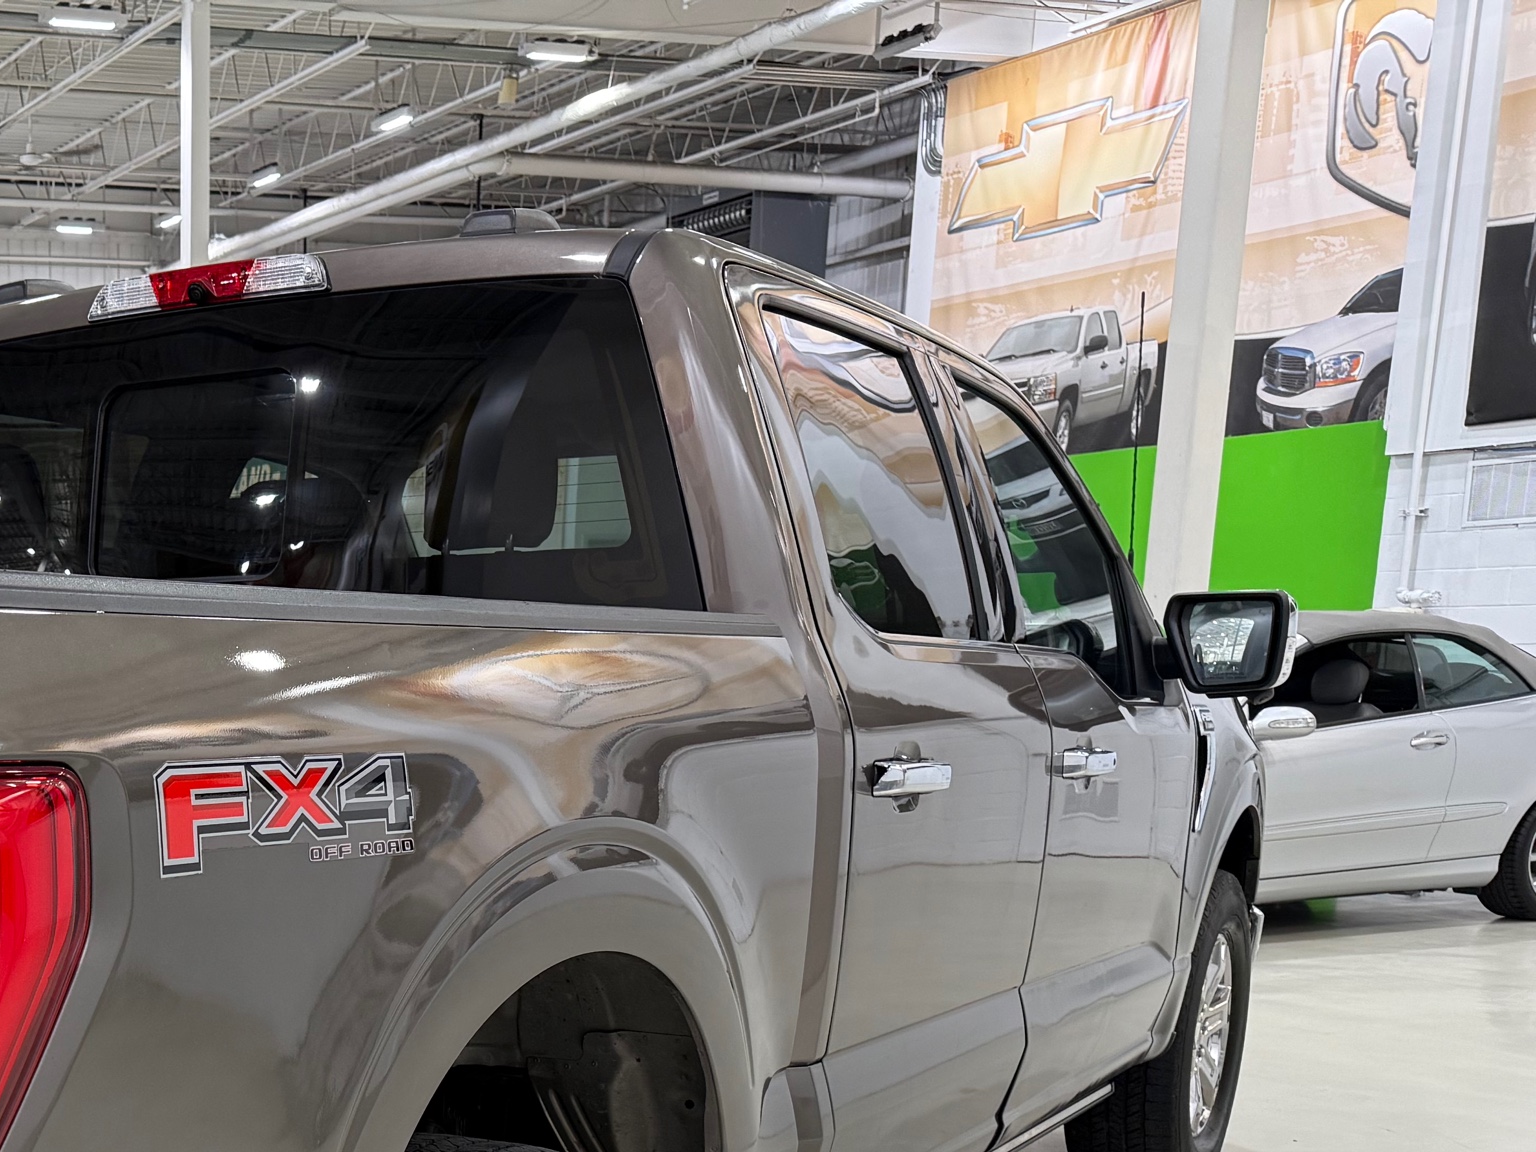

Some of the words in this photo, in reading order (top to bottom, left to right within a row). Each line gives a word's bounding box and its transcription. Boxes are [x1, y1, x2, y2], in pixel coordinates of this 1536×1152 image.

[153, 752, 415, 878] FX4
[309, 843, 352, 862] OFF
[359, 837, 415, 857] ROAD
